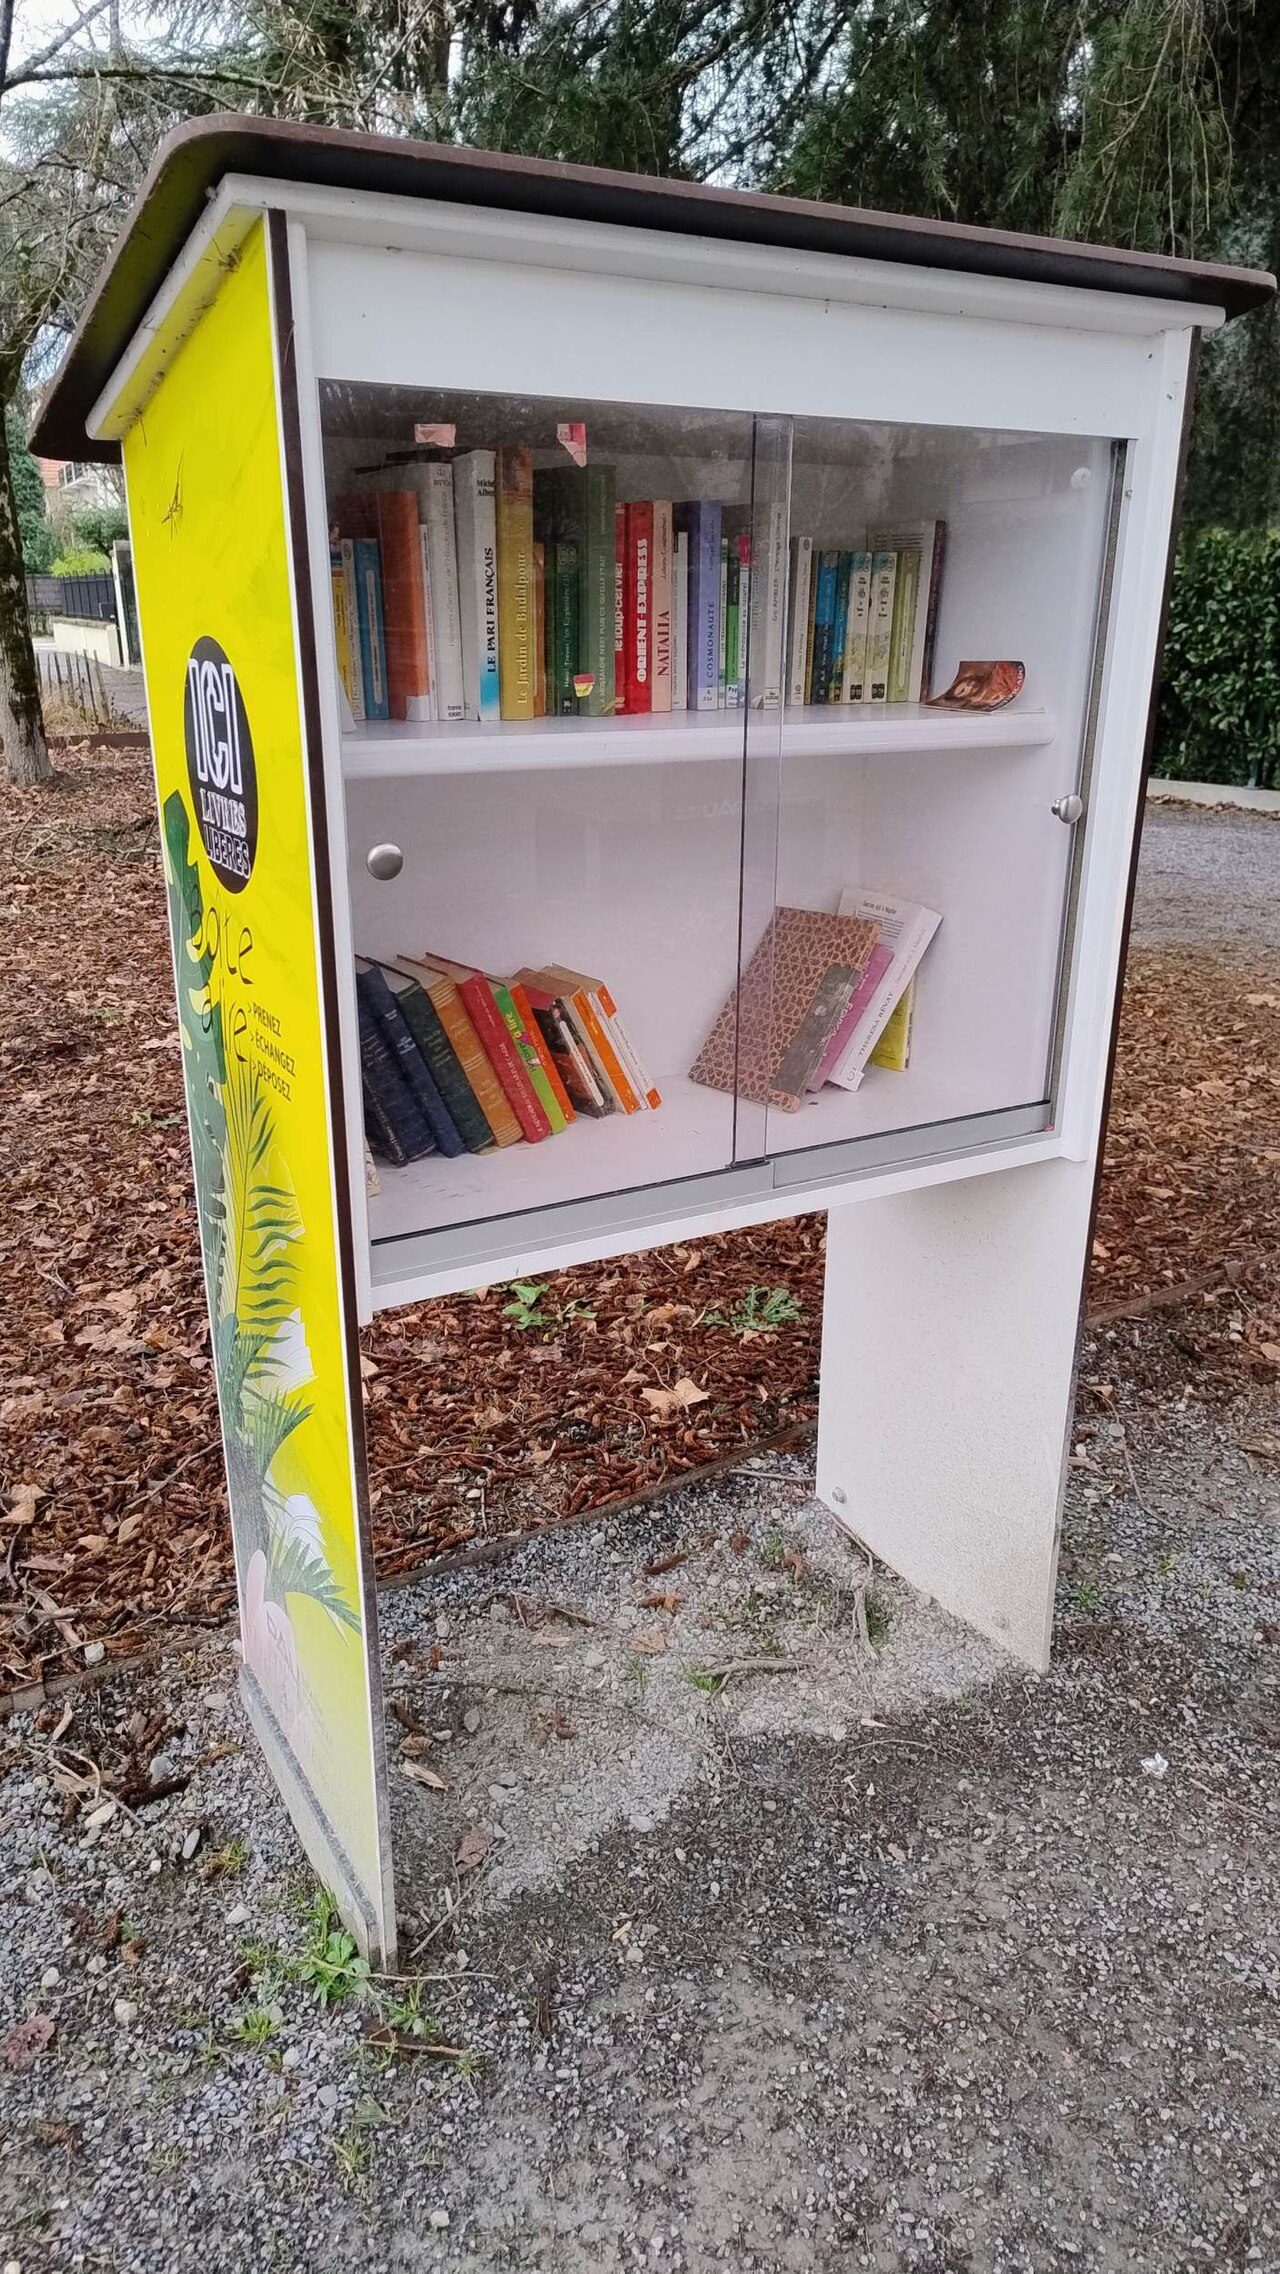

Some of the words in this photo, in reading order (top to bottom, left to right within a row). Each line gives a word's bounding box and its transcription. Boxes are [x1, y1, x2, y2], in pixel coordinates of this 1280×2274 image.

[484, 547, 496, 615] FRANÇAIS
[514, 552, 529, 621] Badalpour
[486, 620, 496, 651] PARI
[515, 627, 527, 640] de
[636, 538, 648, 683] ORIENT-EXPRESS
[487, 656, 496, 673] LE
[515, 645, 530, 685] Jardin
[657, 610, 670, 677] NATALIA
[706, 601, 715, 679] COSMONAUTE
[517, 690, 528, 704] Le
[188, 658, 243, 795] ICI
[199, 788, 247, 838] LIVRES
[204, 824, 251, 880] LIBERES
[252, 1002, 281, 1038] PRENEZ
[505, 1011, 518, 1034] lire
